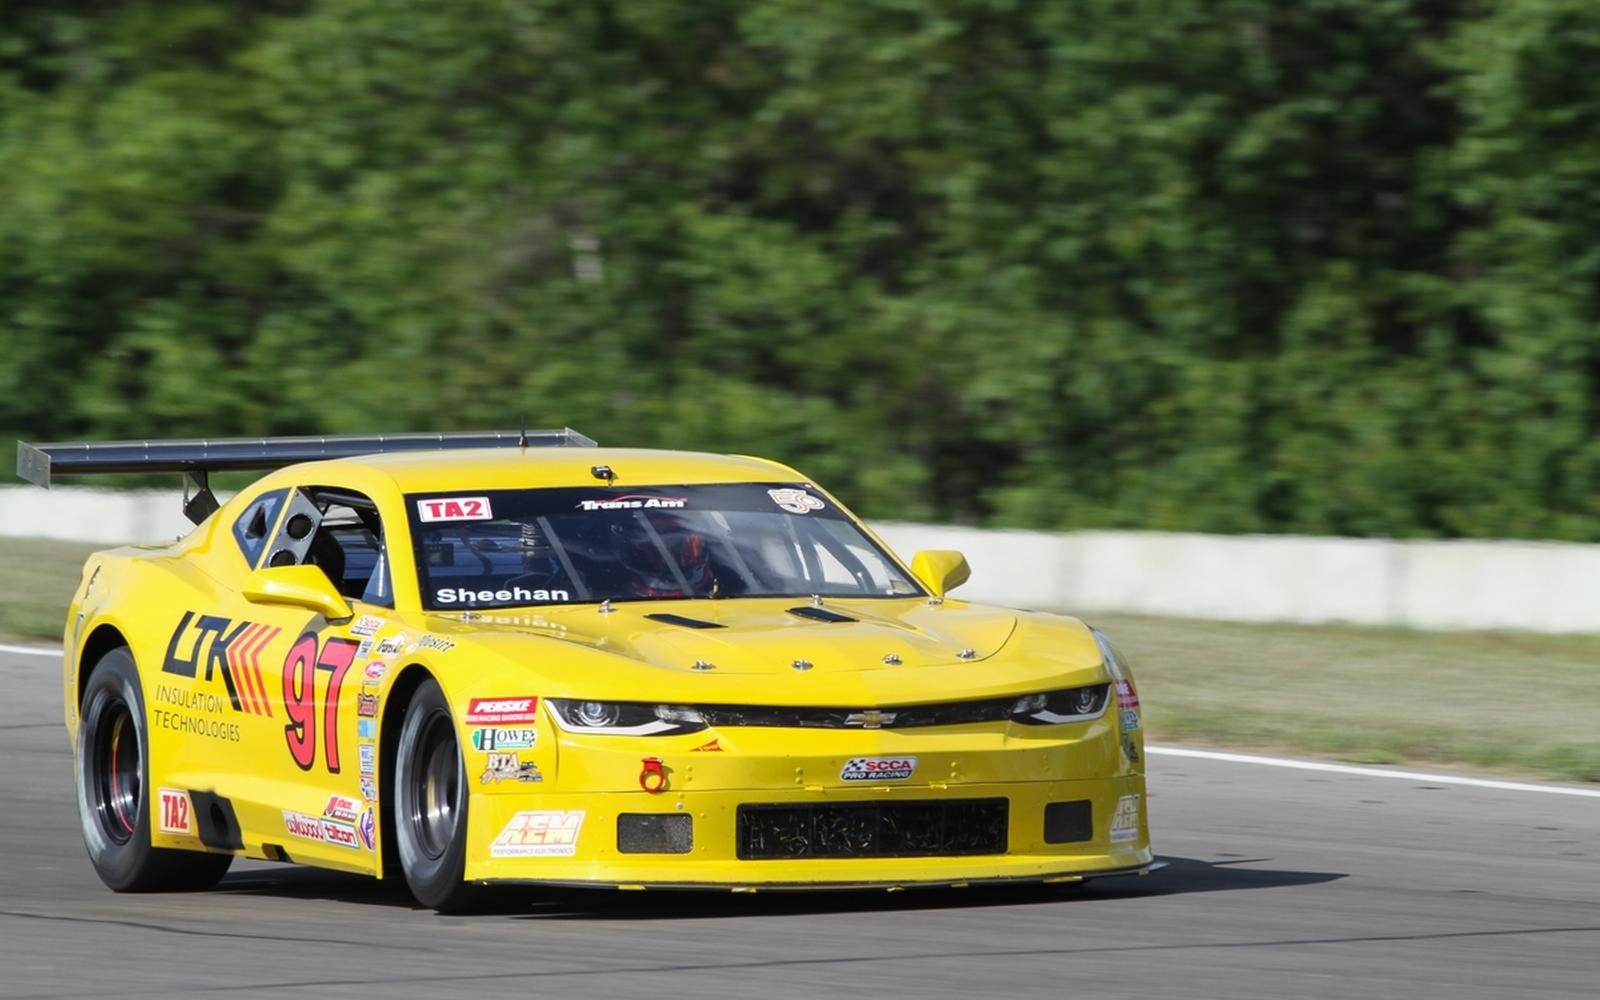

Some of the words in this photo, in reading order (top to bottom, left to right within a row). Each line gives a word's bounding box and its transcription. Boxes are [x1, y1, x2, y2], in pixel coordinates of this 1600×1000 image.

[426, 501, 484, 518] TA2
[581, 500, 643, 511] Trans
[644, 498, 685, 508] Am
[436, 587, 569, 603] Sheehan
[162, 610, 252, 712] LTK
[155, 684, 224, 714] INSULATION
[282, 631, 360, 774] 97
[474, 699, 533, 713] PENSKE
[154, 709, 241, 742] TECHNOLOGIES
[478, 728, 533, 751] HOWE
[487, 752, 519, 769] BTA
[865, 760, 911, 770] SCCA
[868, 771, 910, 779] RACING
[163, 795, 188, 830] TA2
